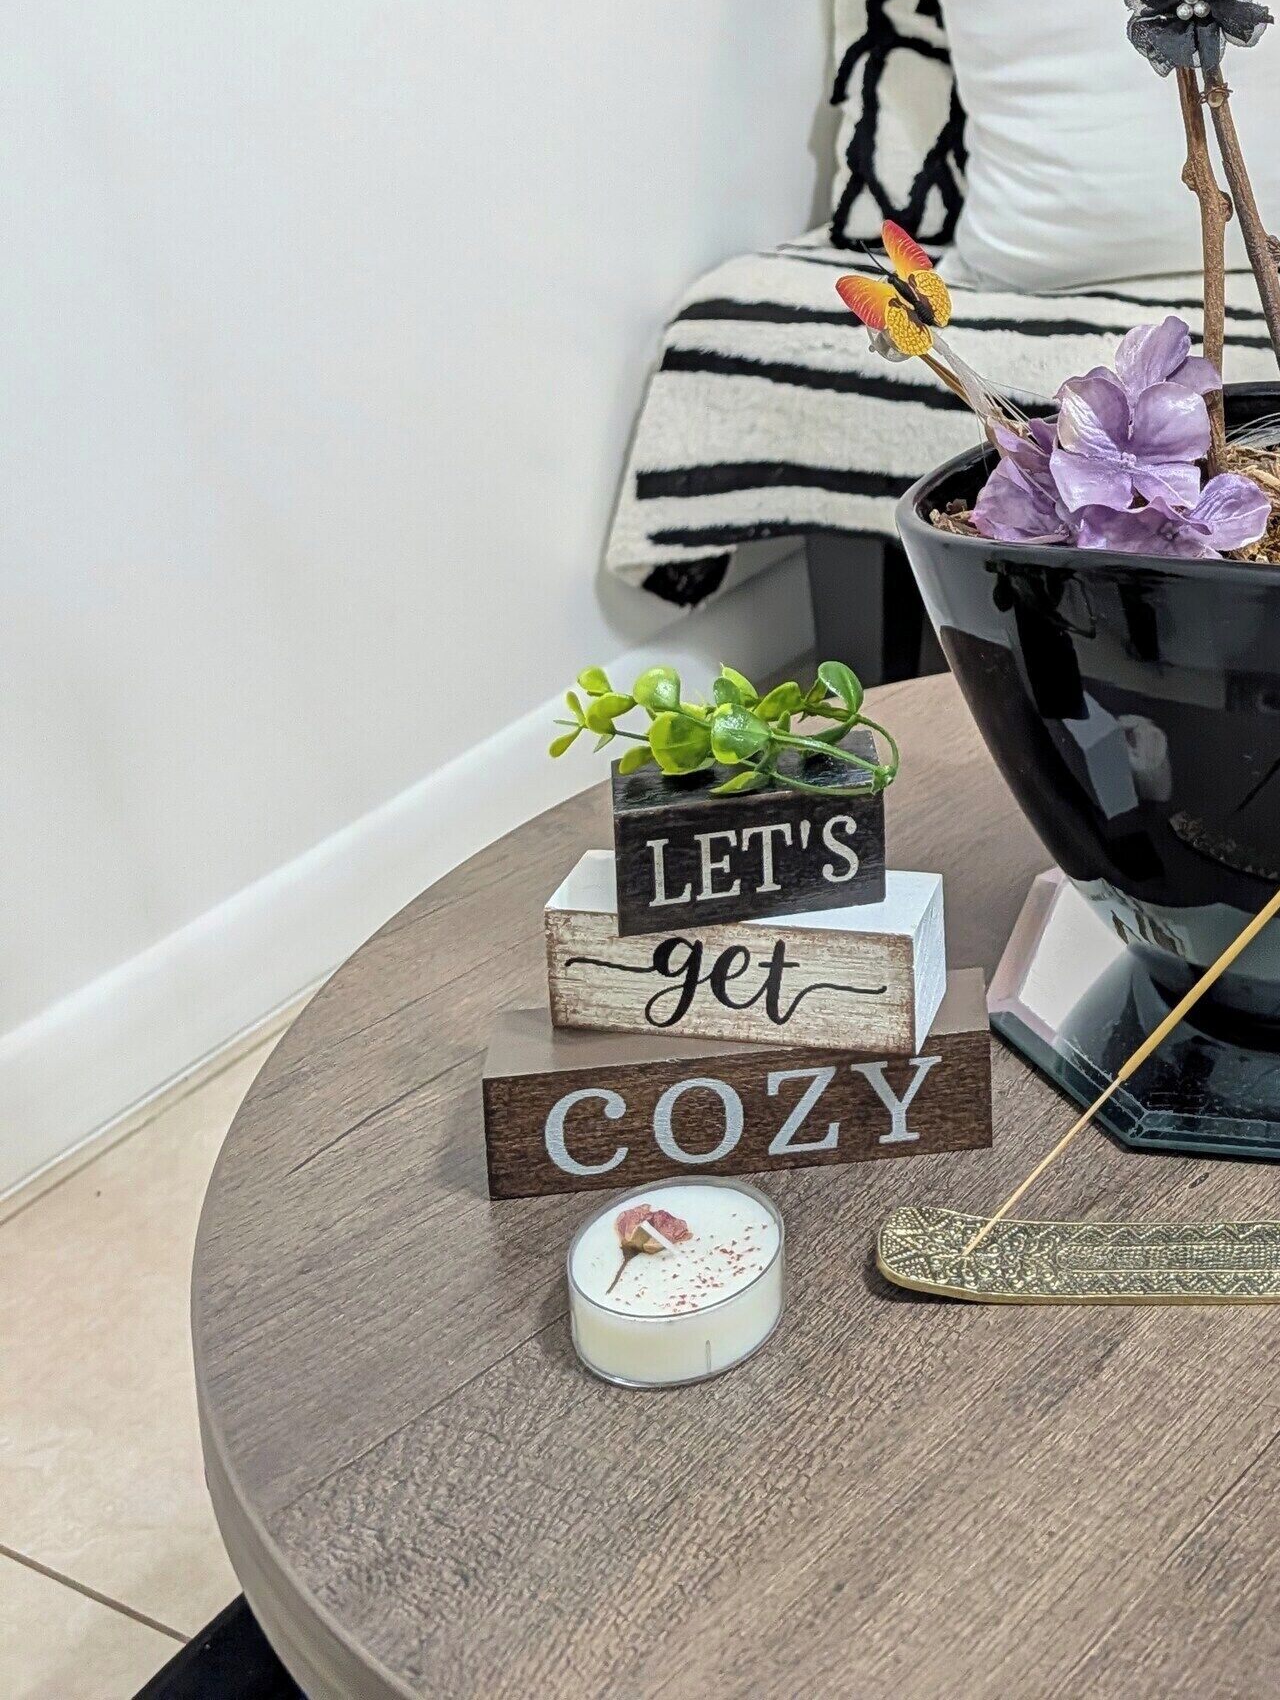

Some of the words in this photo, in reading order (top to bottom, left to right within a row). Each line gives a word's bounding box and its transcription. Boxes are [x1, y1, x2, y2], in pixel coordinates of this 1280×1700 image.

[645, 814, 860, 908] LET'S
[563, 935, 888, 1028] get
[543, 1054, 943, 1177] COZY
